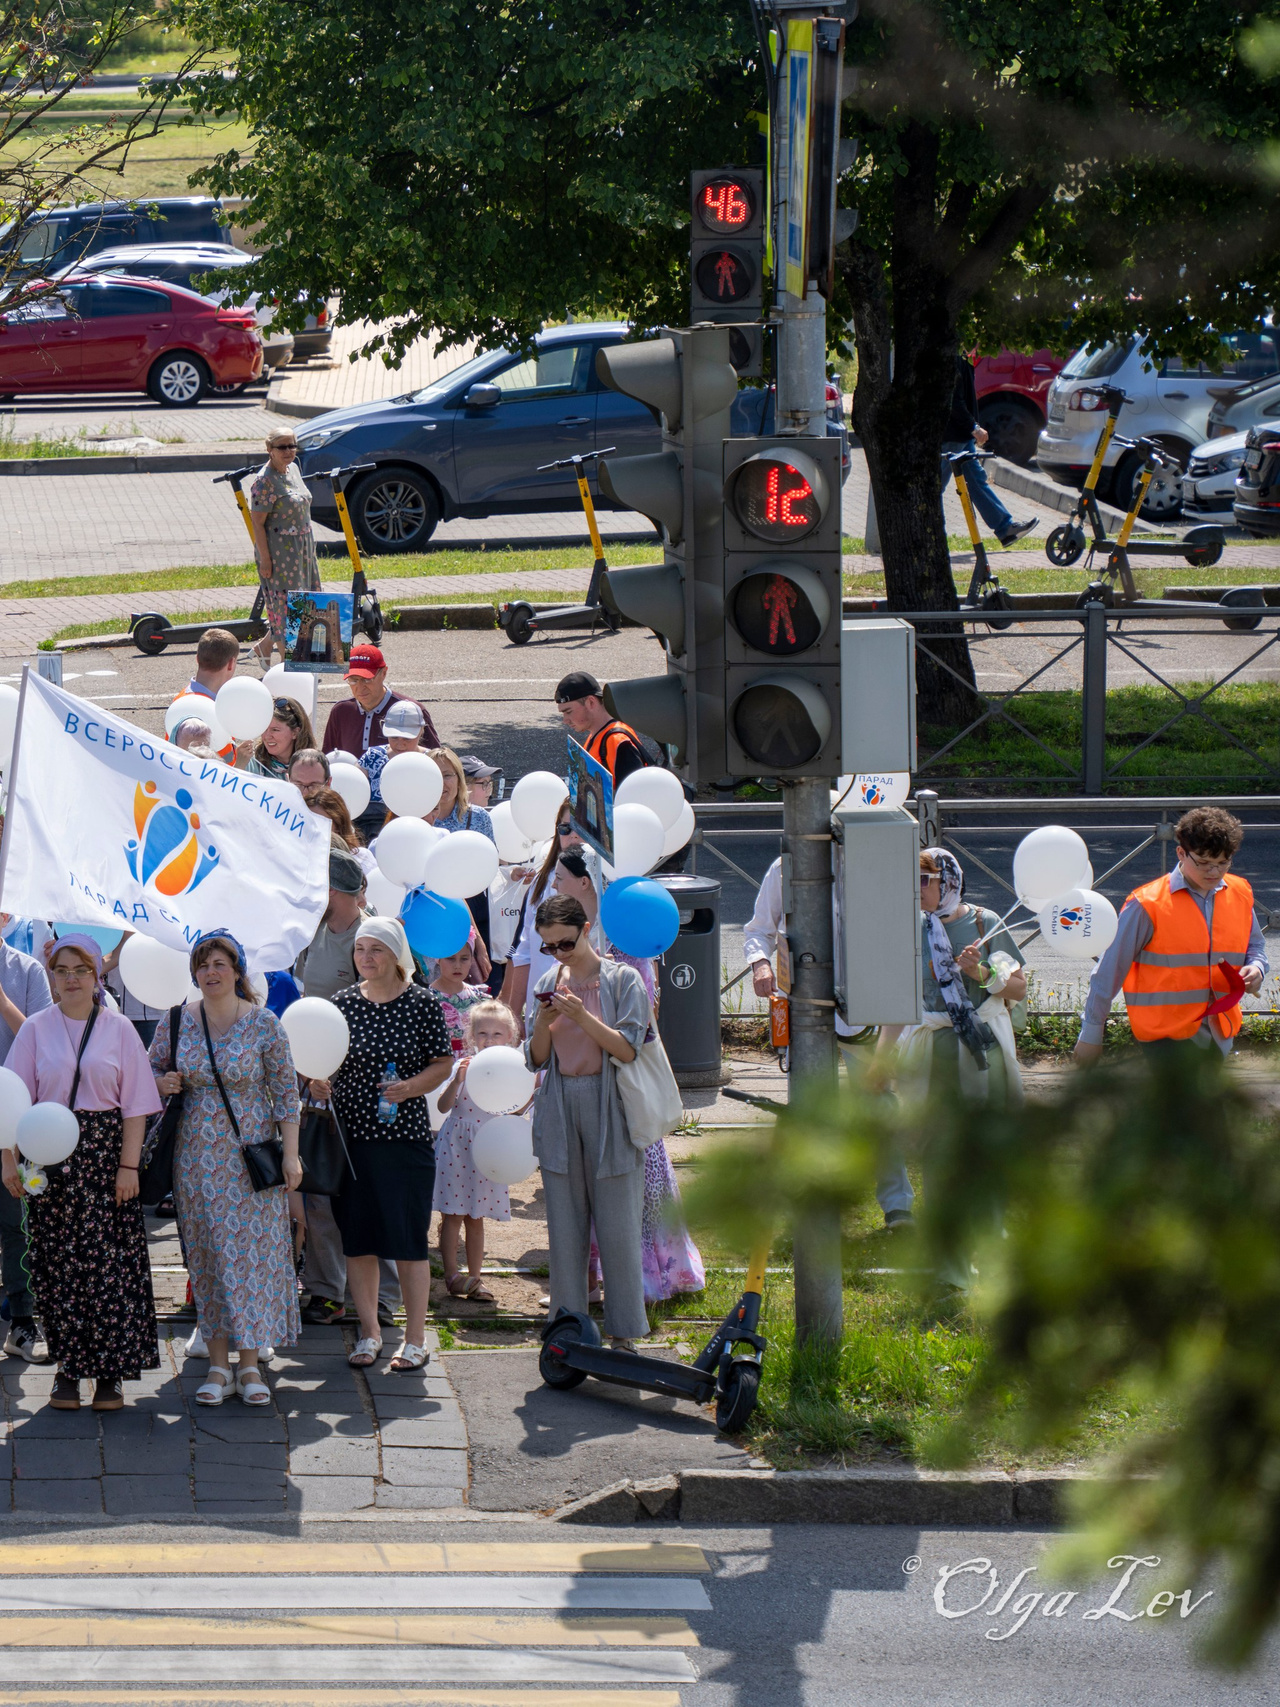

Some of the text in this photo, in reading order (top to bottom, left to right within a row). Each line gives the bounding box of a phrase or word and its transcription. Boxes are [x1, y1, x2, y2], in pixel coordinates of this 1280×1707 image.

[705, 185, 747, 223] 46
[767, 463, 814, 525] 12
[64, 712, 307, 838] ВСЕРОССИЙСКИЙ
[858, 775, 894, 786] ПАРАД
[70, 871, 150, 923] ПАРАД
[1051, 905, 1059, 936] СЕМЬИ
[1082, 903, 1092, 938] ПАРАД
